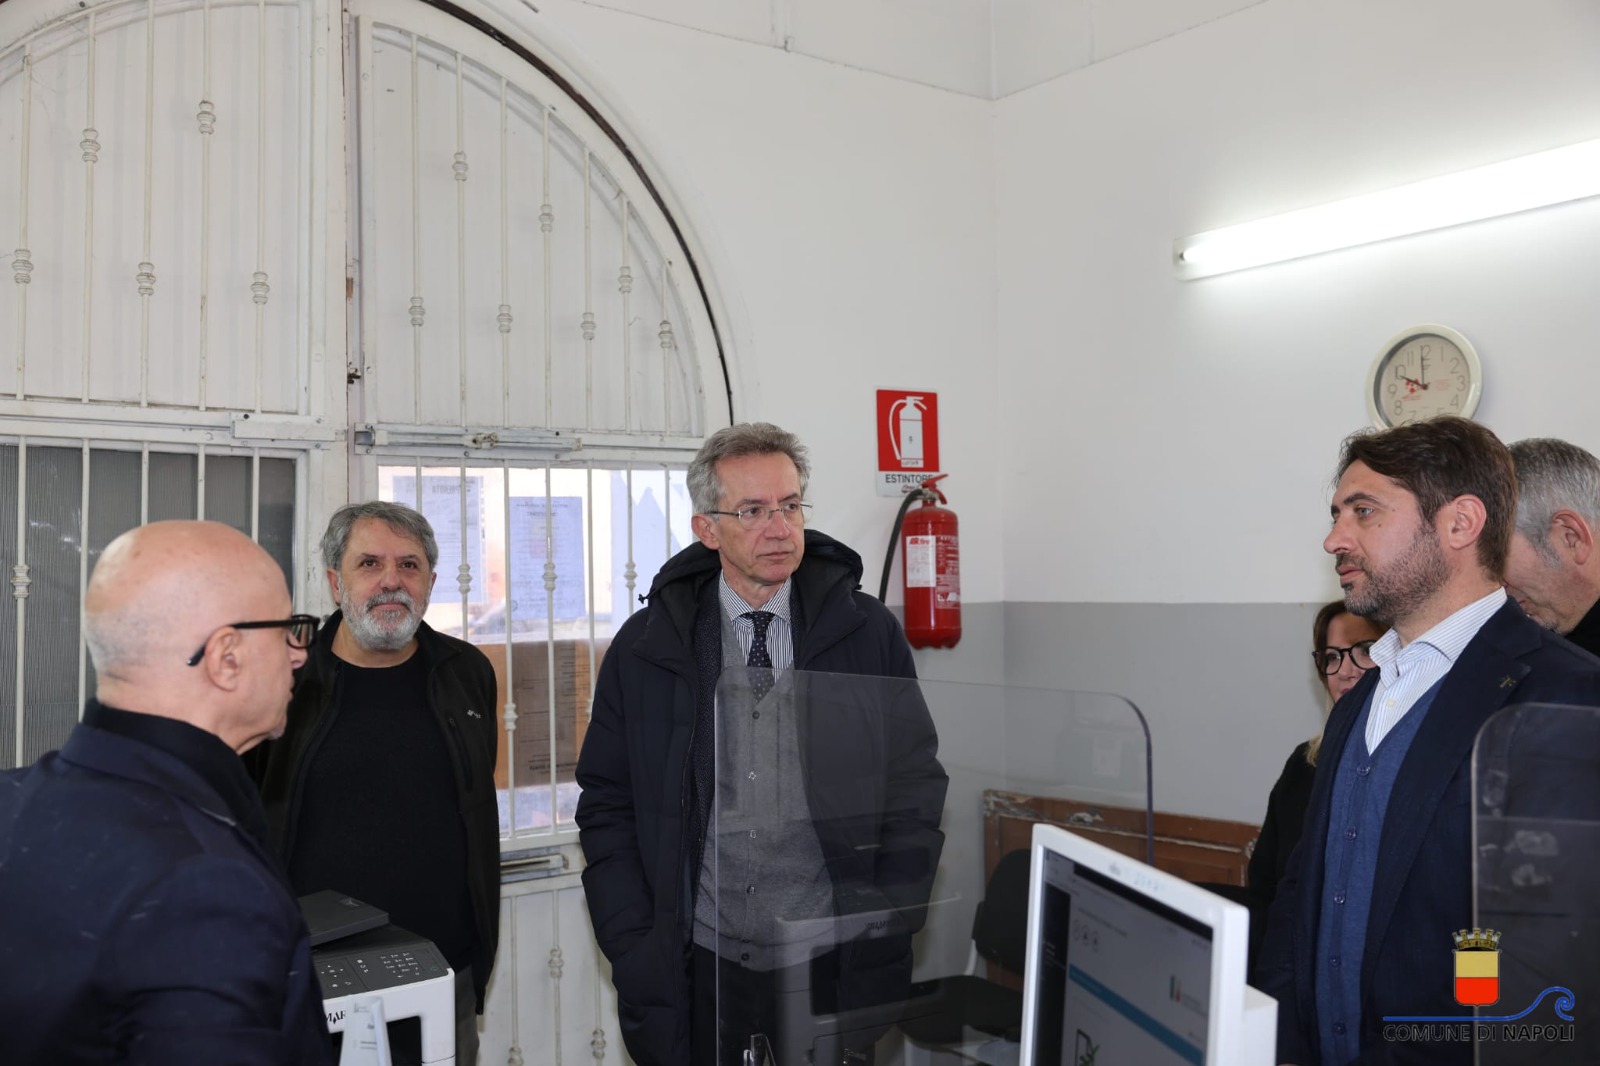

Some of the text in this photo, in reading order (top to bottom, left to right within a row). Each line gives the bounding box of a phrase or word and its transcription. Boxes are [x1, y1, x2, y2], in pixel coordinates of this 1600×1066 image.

[1449, 357, 1460, 374] 2
[1387, 383, 1398, 399] 9
[1456, 375, 1466, 392] 3
[1394, 400, 1403, 416] 8
[1449, 393, 1459, 410] 4
[885, 474, 933, 484] ESTINTOR
